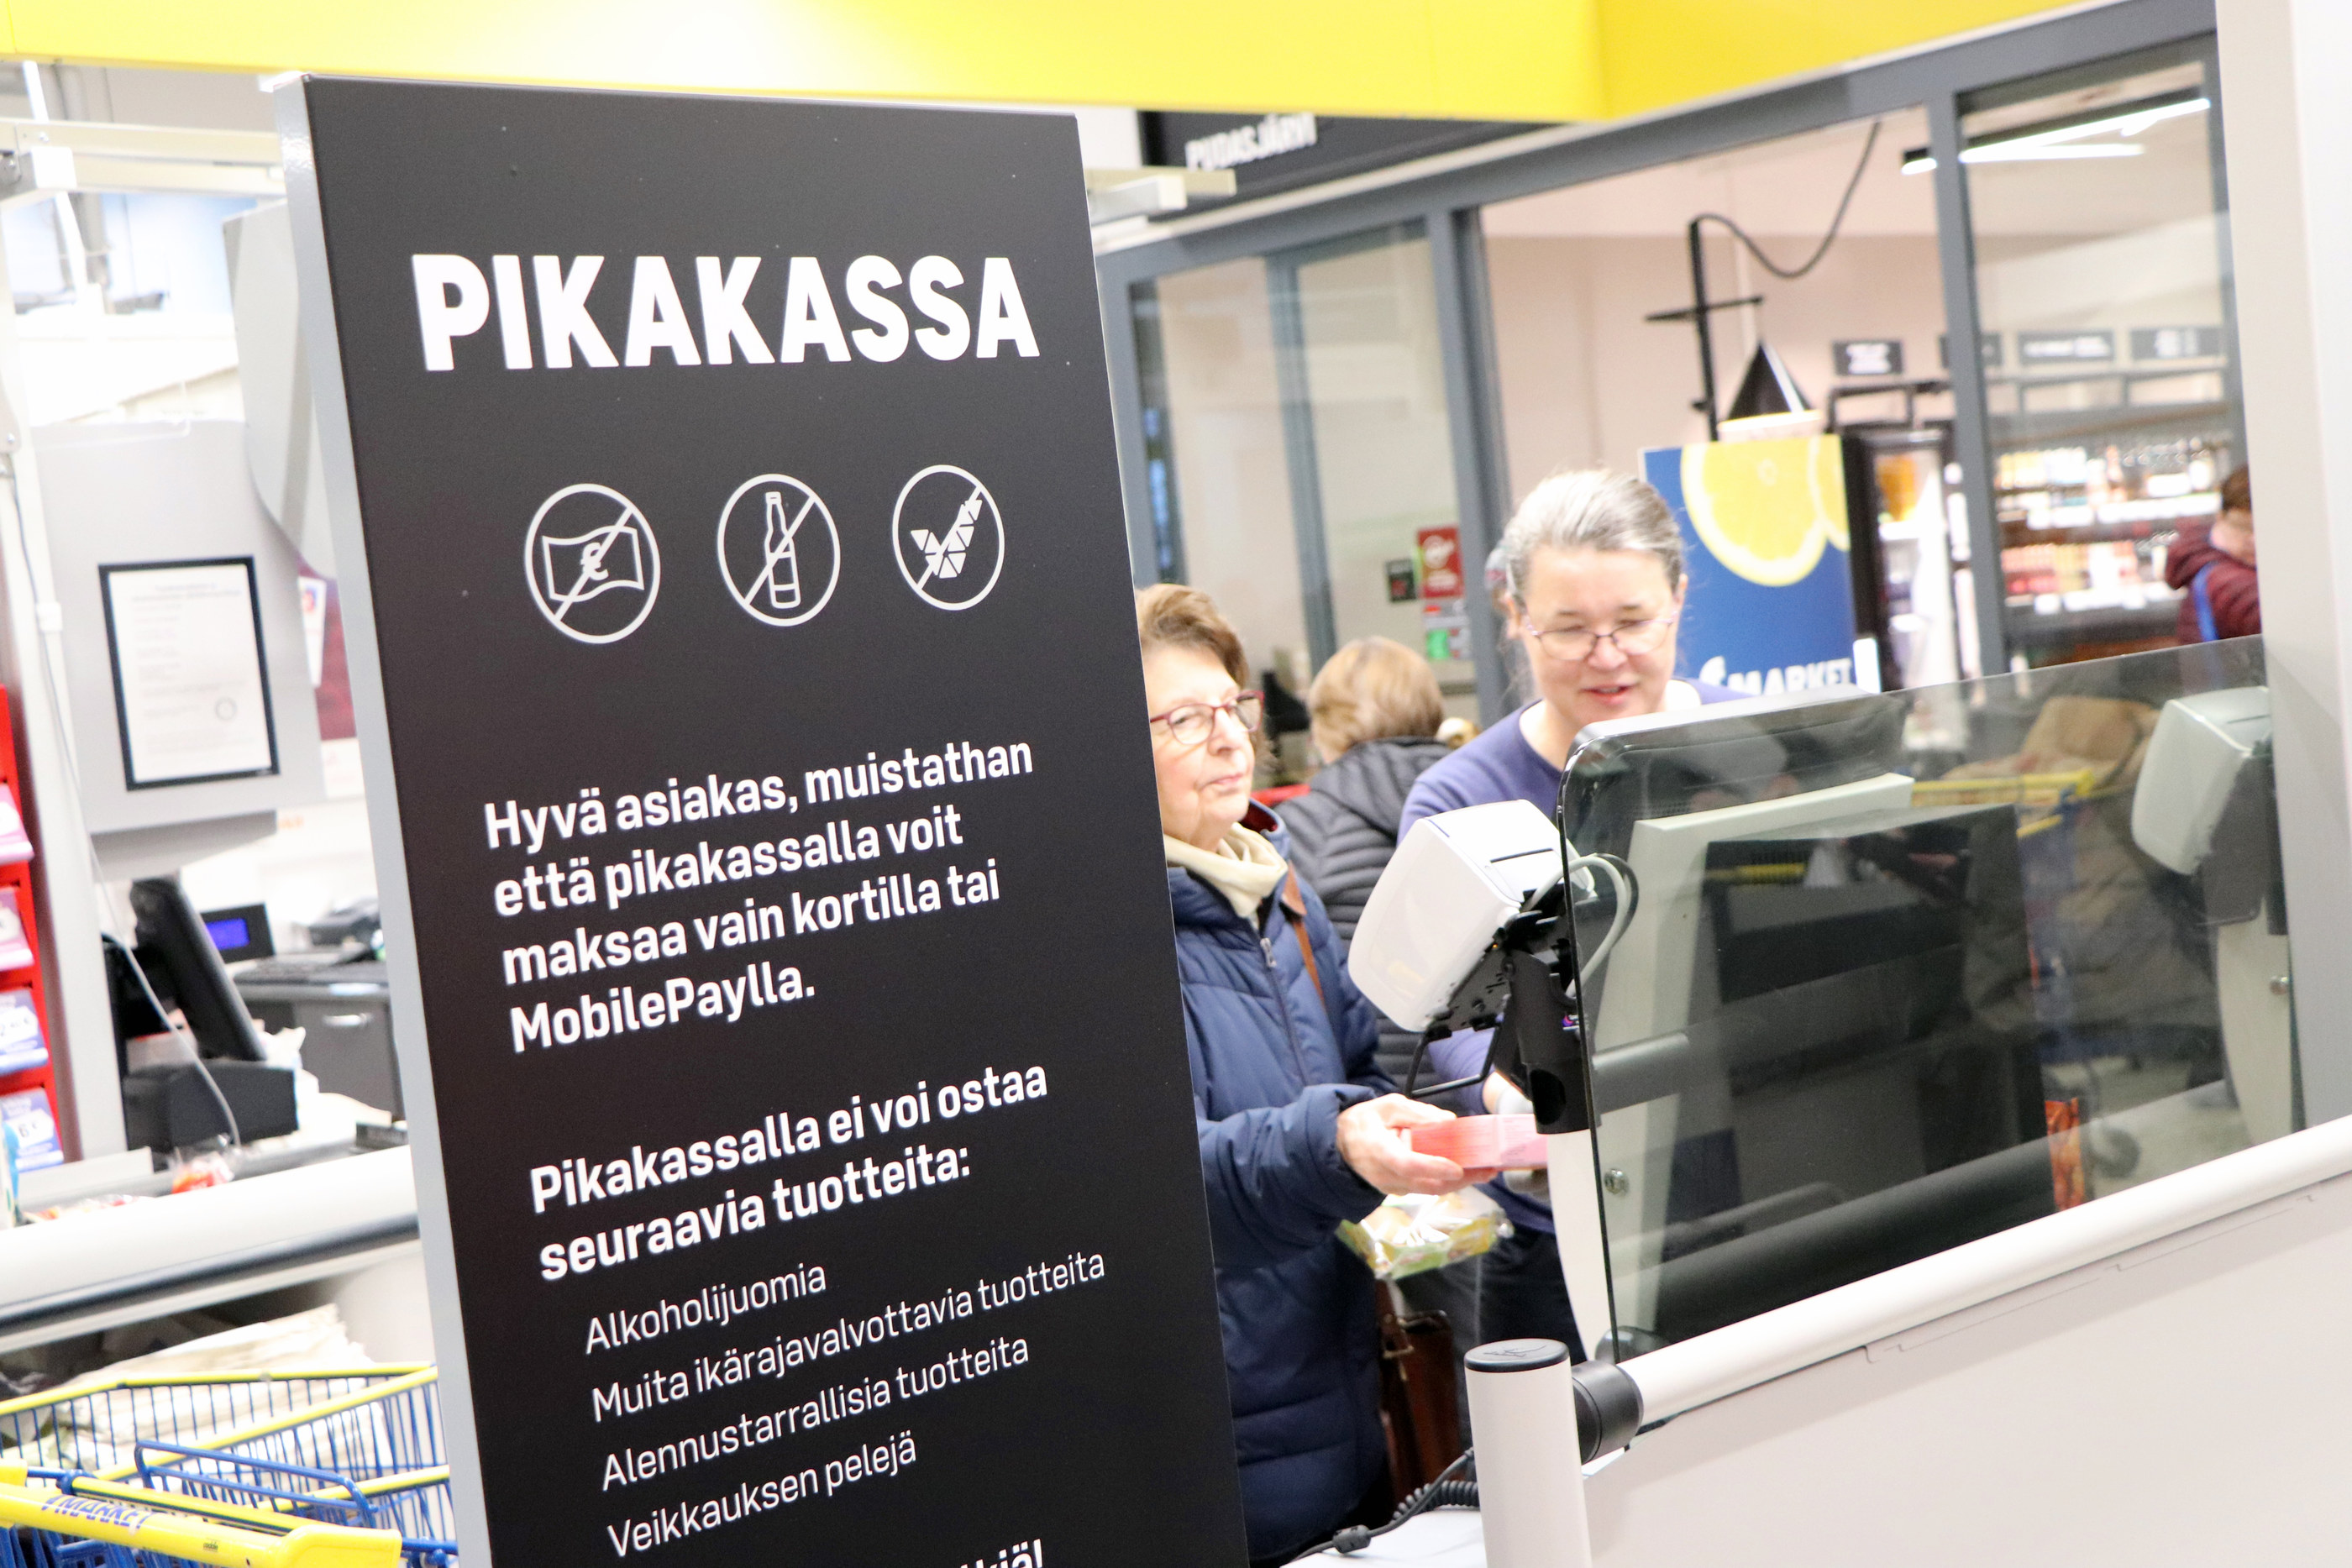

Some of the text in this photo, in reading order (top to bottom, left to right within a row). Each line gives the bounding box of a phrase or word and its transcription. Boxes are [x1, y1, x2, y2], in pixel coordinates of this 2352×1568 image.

[411, 254, 1040, 372] PIKAKASSA
[485, 742, 1032, 854] Hyvä asiakas, muistathan
[495, 805, 963, 916] että pikakassalla voit
[503, 858, 999, 984] maksaa vain kortilla tai
[511, 962, 815, 1052] MobilePaylla.
[531, 1067, 1047, 1213] Pikakassalla ei voi ostaa
[540, 1145, 970, 1280] seuraavia tuotteita:
[586, 1263, 826, 1354] Alkoholijuomia
[593, 1251, 1105, 1422] Muita ikärajavalvottavia tuotteita
[603, 1337, 1029, 1491] Alennustarrallisia tuotteita
[607, 1430, 916, 1556] Veikkauksen pelejä
